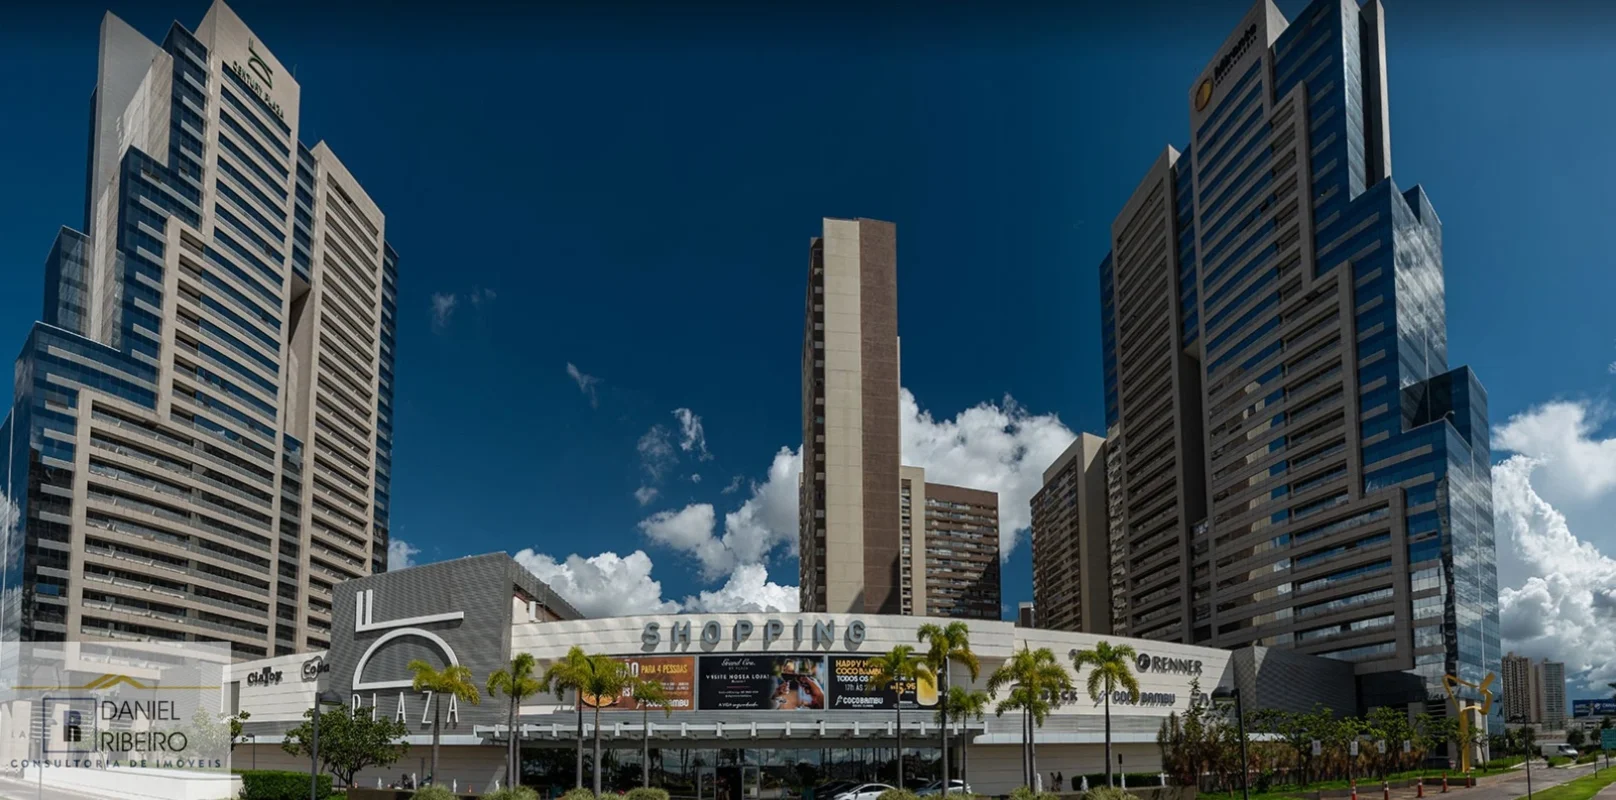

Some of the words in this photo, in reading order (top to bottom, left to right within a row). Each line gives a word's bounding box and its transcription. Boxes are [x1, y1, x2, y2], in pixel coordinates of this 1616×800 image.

[232, 60, 263, 97] CENTURY
[264, 92, 284, 119] PLAZA
[642, 619, 866, 645] SHOPPING
[662, 664, 688, 674] PESSOAS
[835, 659, 860, 668] HAPPY
[1151, 656, 1203, 674] RENNER
[835, 667, 858, 675] COCO
[1141, 692, 1176, 704] BAMBU
